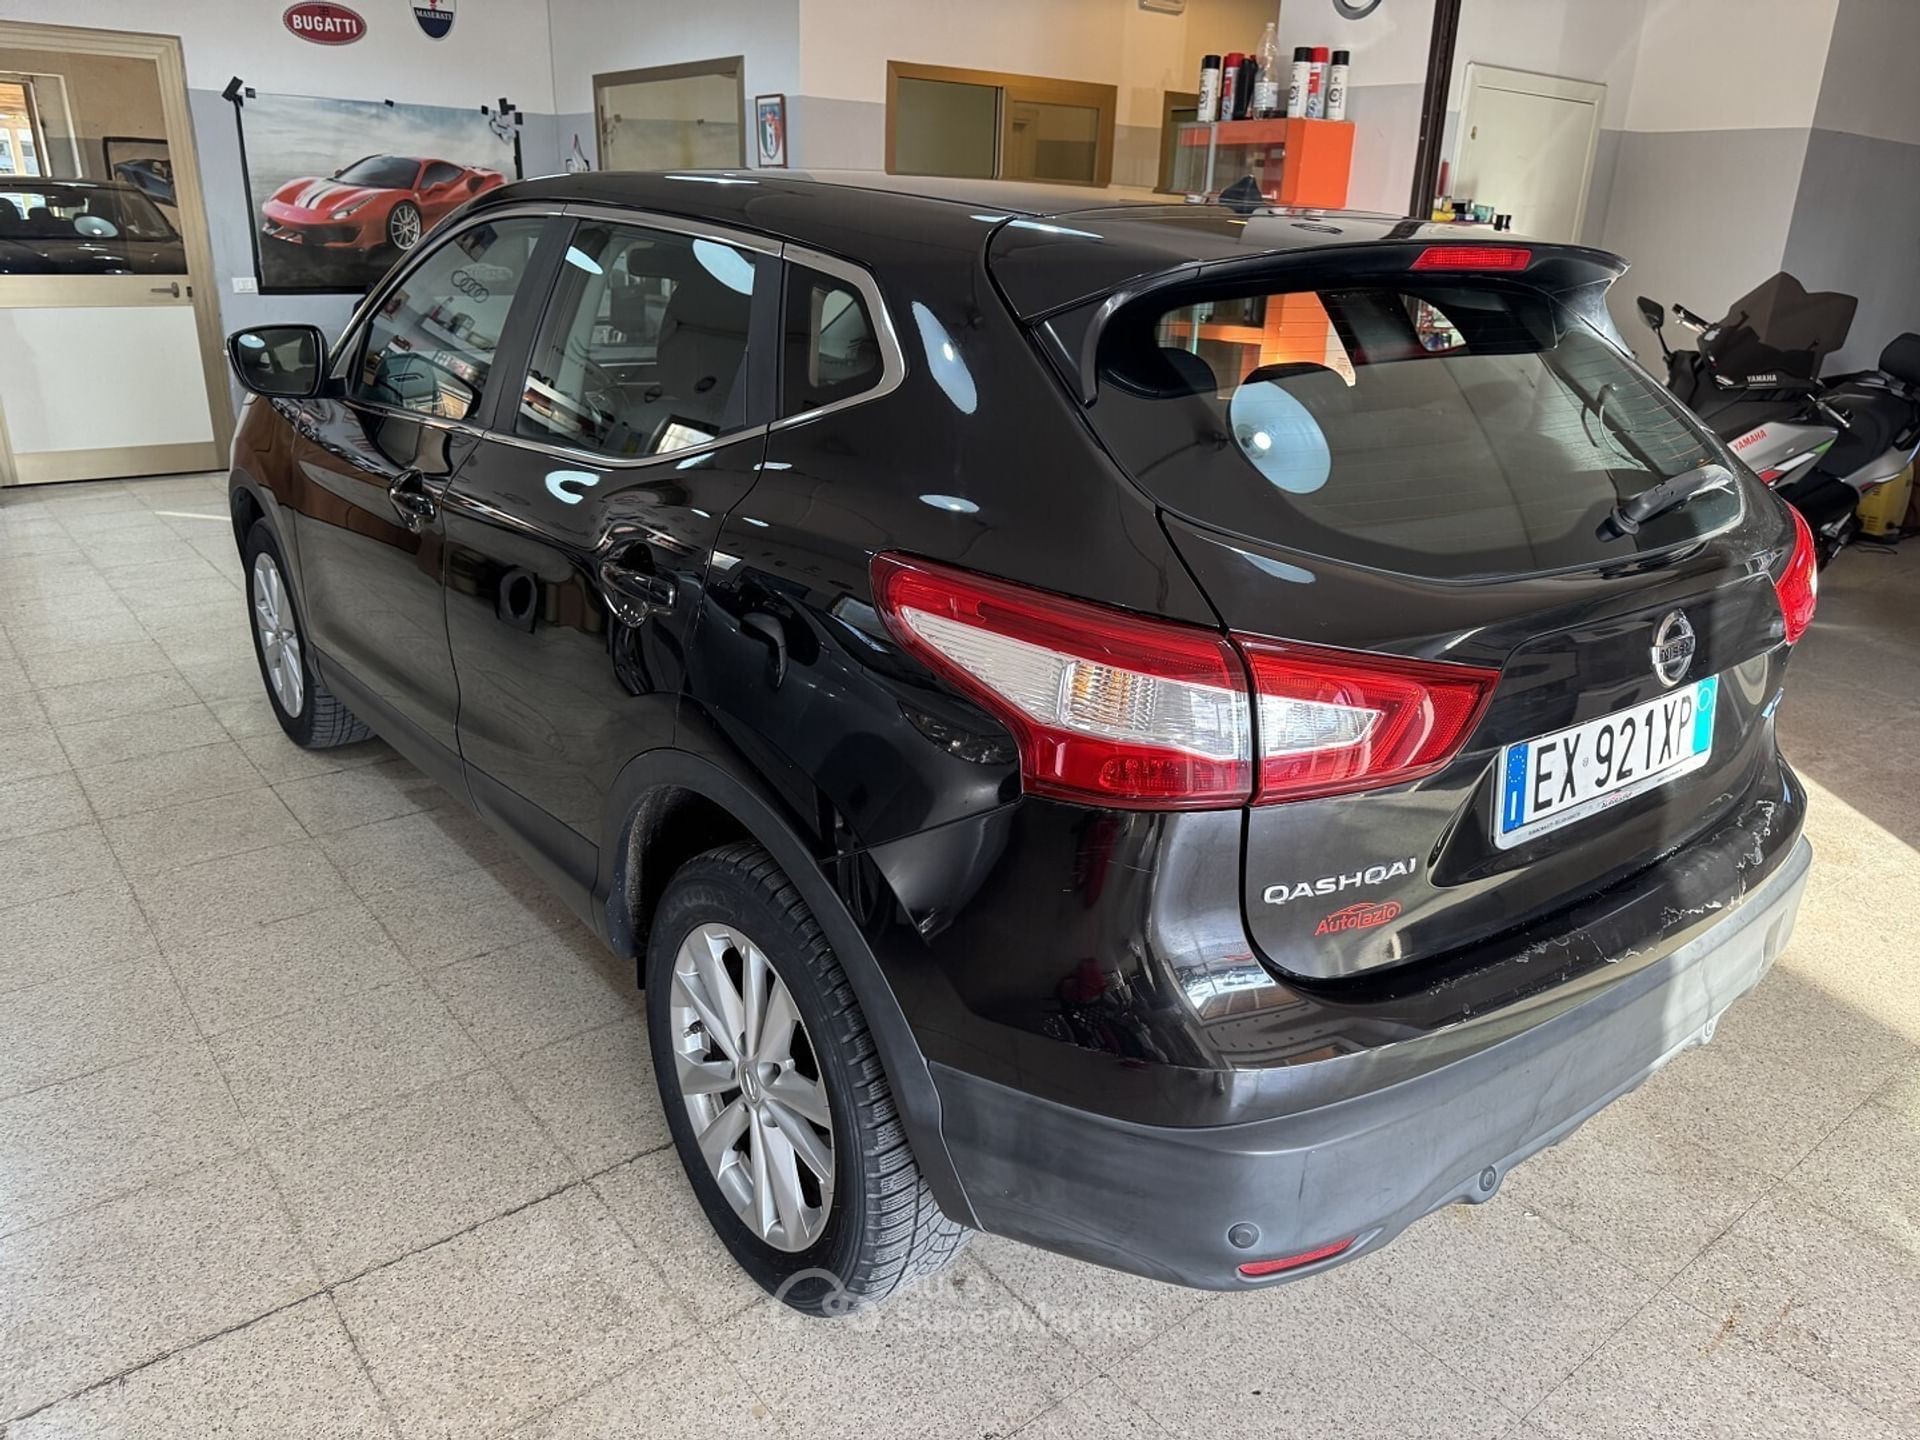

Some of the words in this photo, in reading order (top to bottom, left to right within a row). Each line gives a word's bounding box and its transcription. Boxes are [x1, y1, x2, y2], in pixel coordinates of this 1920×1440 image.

[291, 13, 358, 34] BUGATTI
[415, 9, 452, 20] MASERATI
[1746, 373, 1777, 383] YAMAHA
[1733, 430, 1767, 451] YAMAHA
[1532, 732, 1582, 813] EX
[1594, 694, 1693, 789] 921XP
[1263, 857, 1417, 905] QASHQAI
